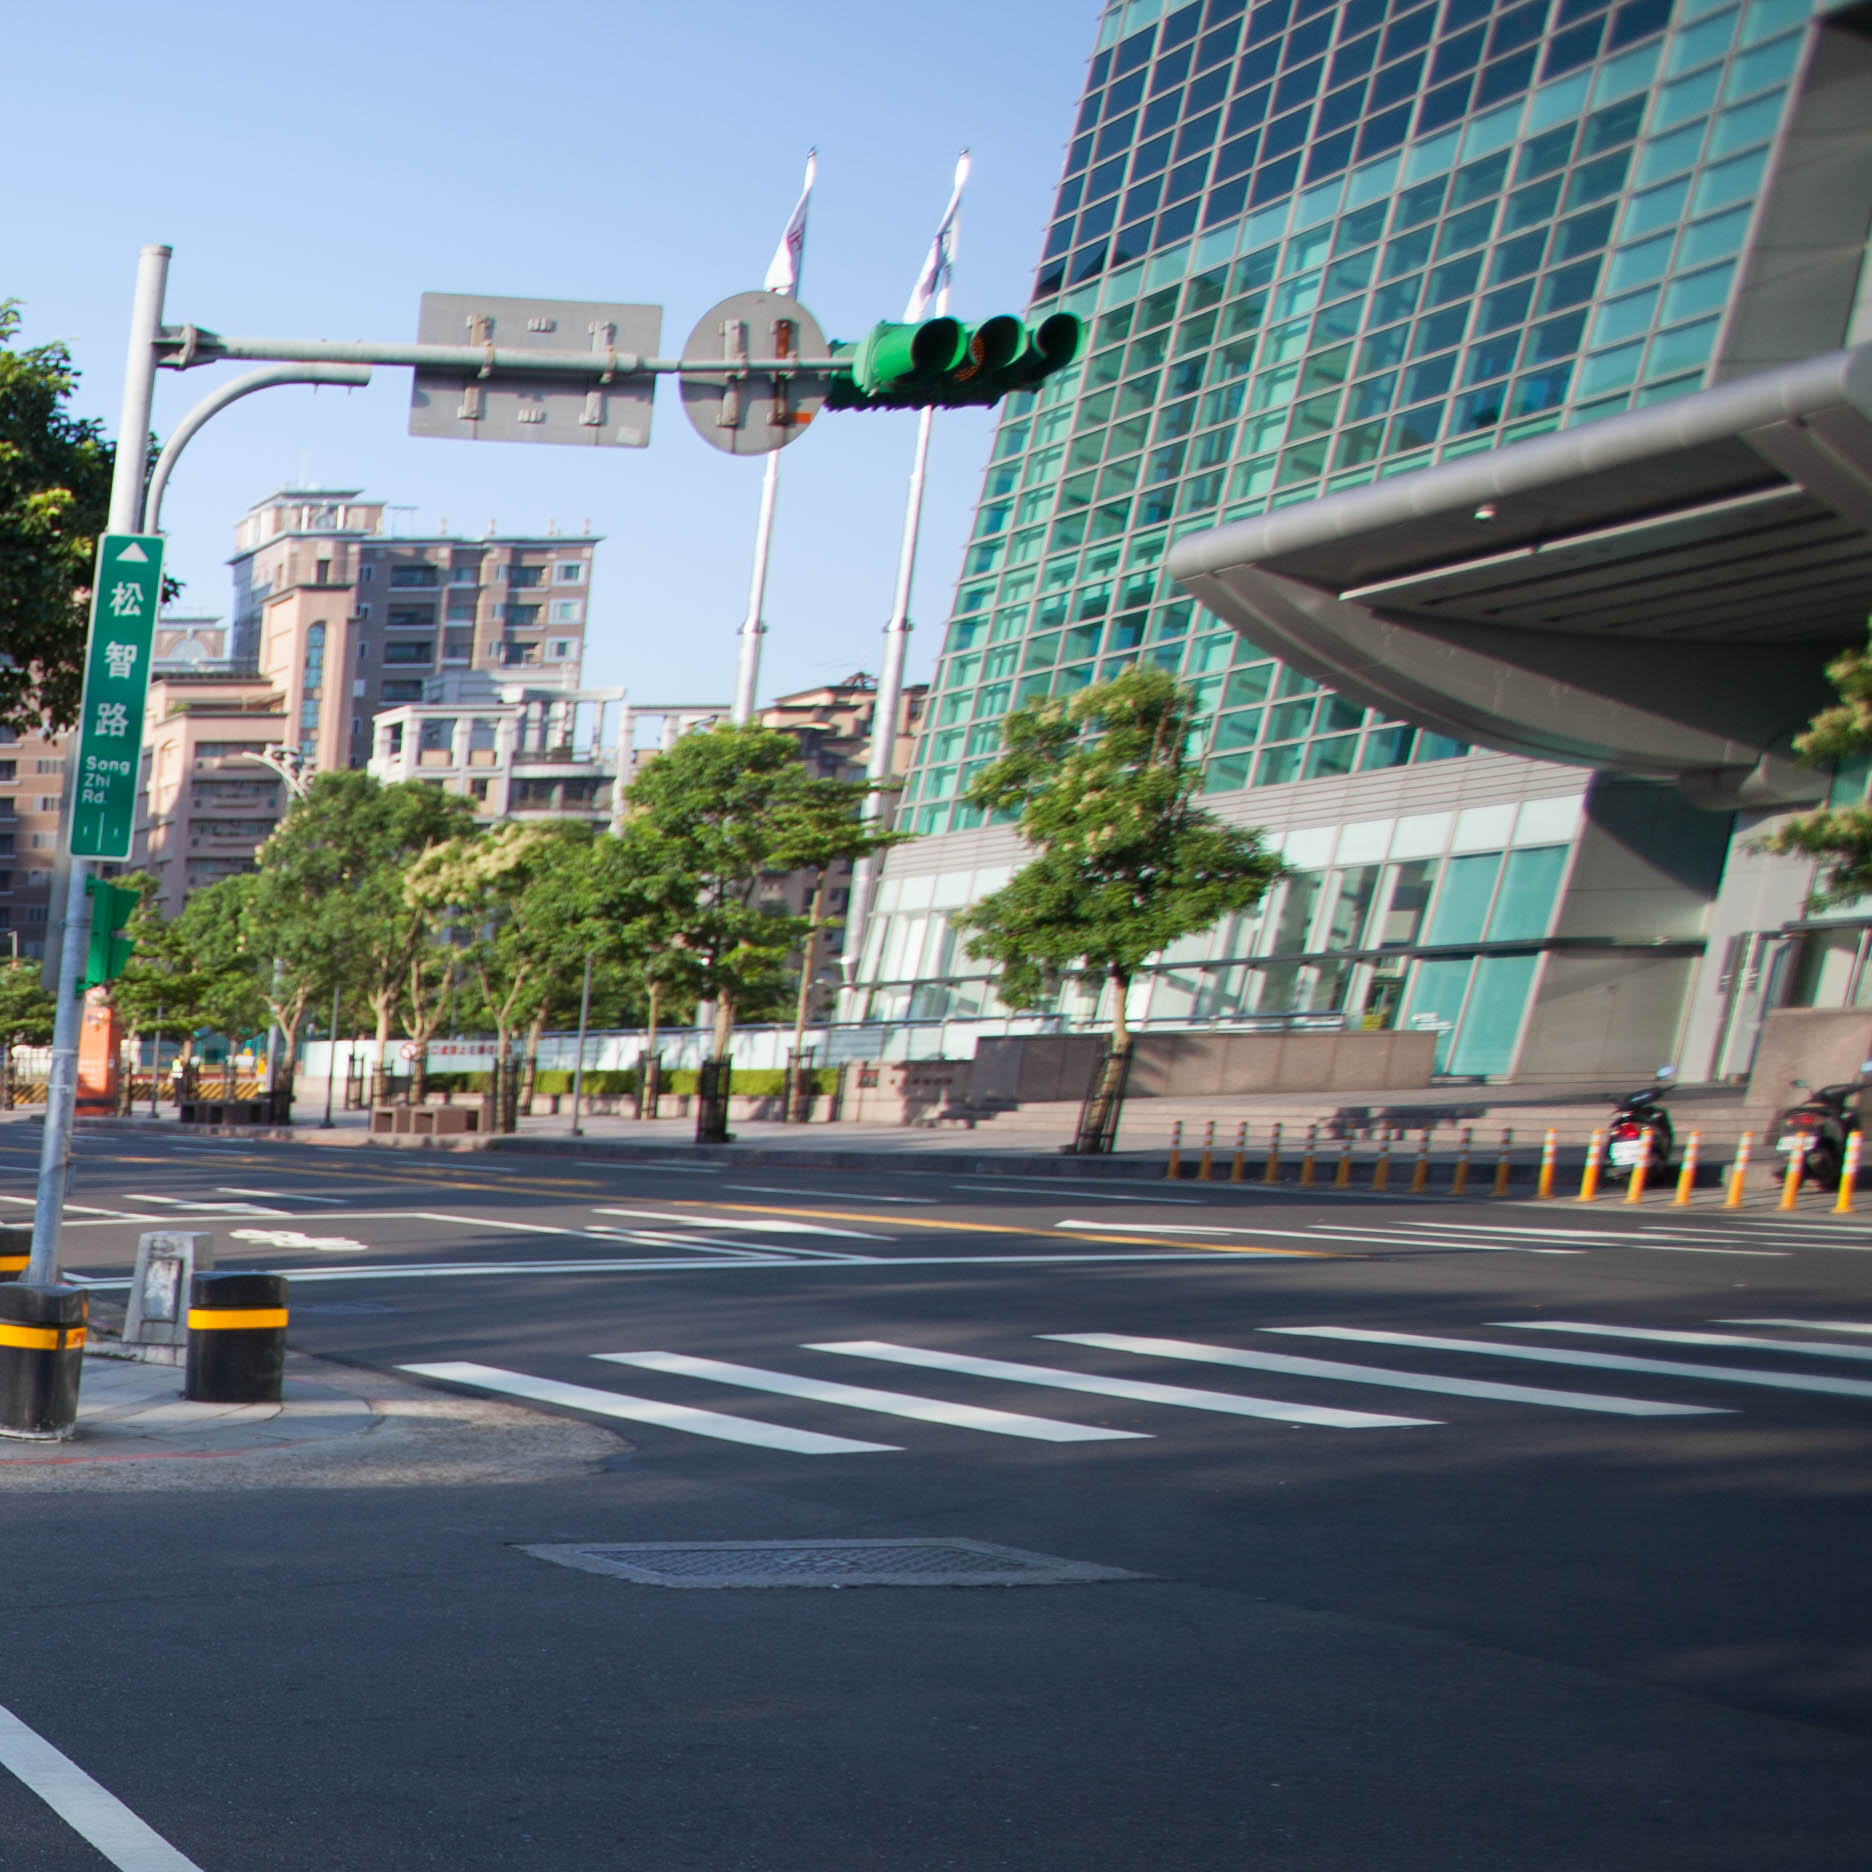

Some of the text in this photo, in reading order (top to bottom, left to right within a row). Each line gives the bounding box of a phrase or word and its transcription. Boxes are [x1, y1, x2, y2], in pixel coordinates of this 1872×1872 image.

[94, 581, 144, 737] 松智路
[86, 756, 131, 776] Song
[84, 773, 111, 788] Zhi
